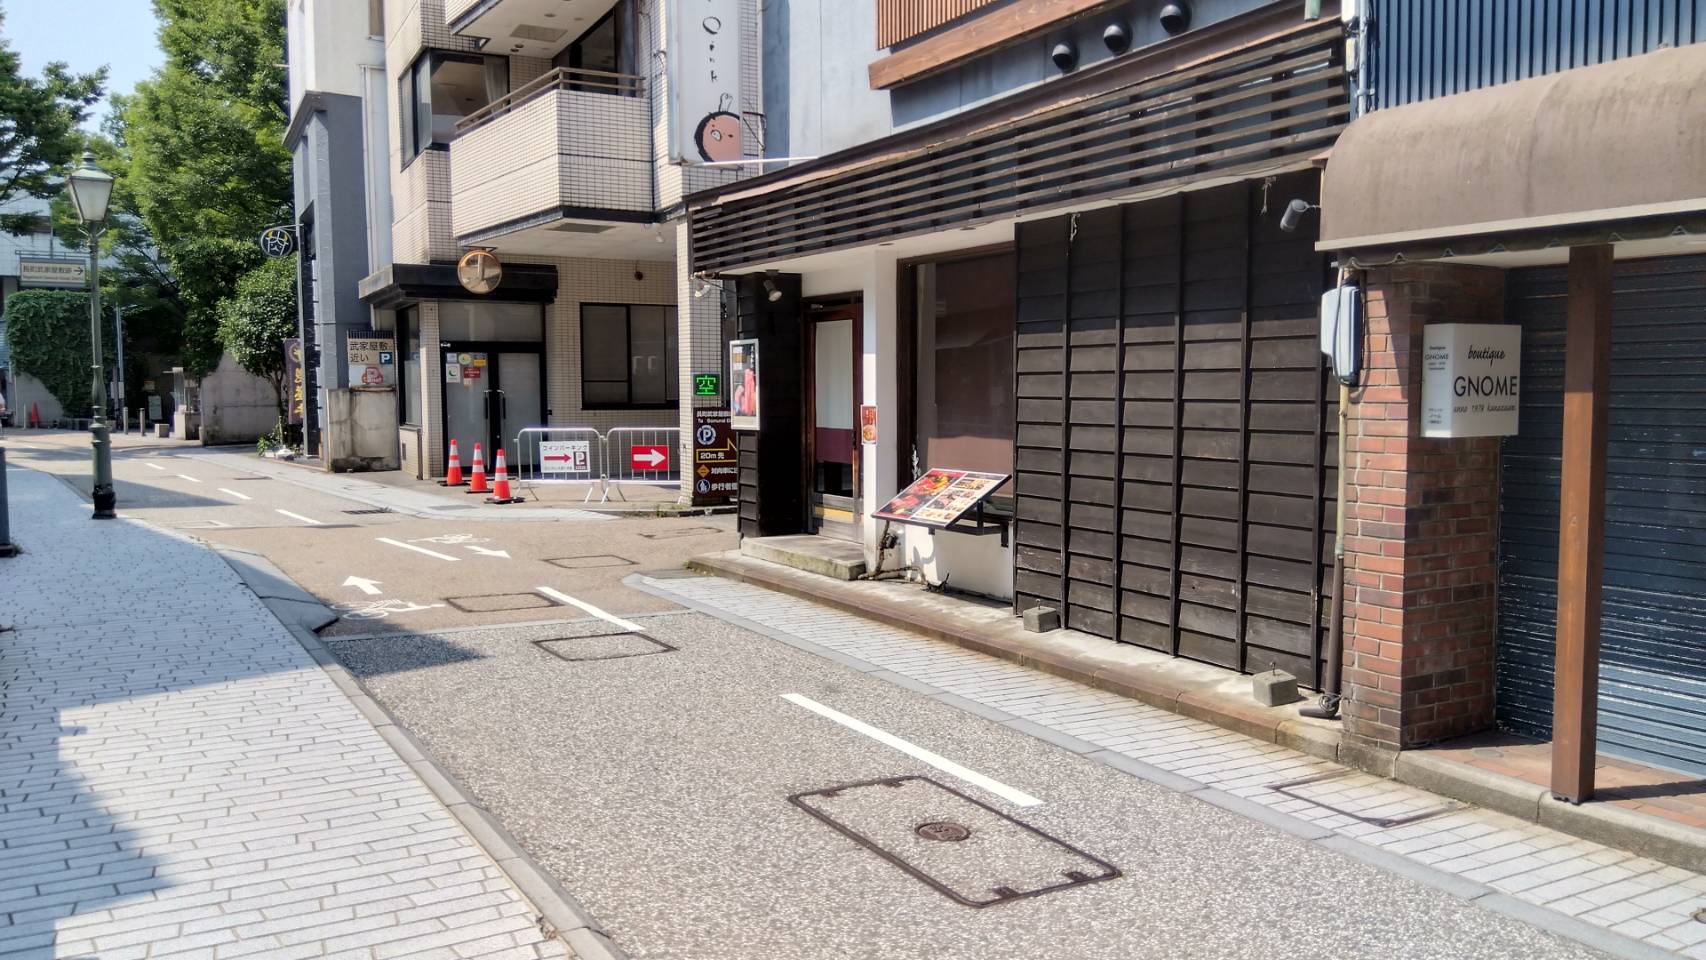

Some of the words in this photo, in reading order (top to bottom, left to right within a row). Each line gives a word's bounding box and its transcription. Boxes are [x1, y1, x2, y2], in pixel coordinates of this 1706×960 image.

[1467, 345, 1506, 368] boutique
[696, 375, 716, 395] 空
[1454, 376, 1517, 396] GNOME
